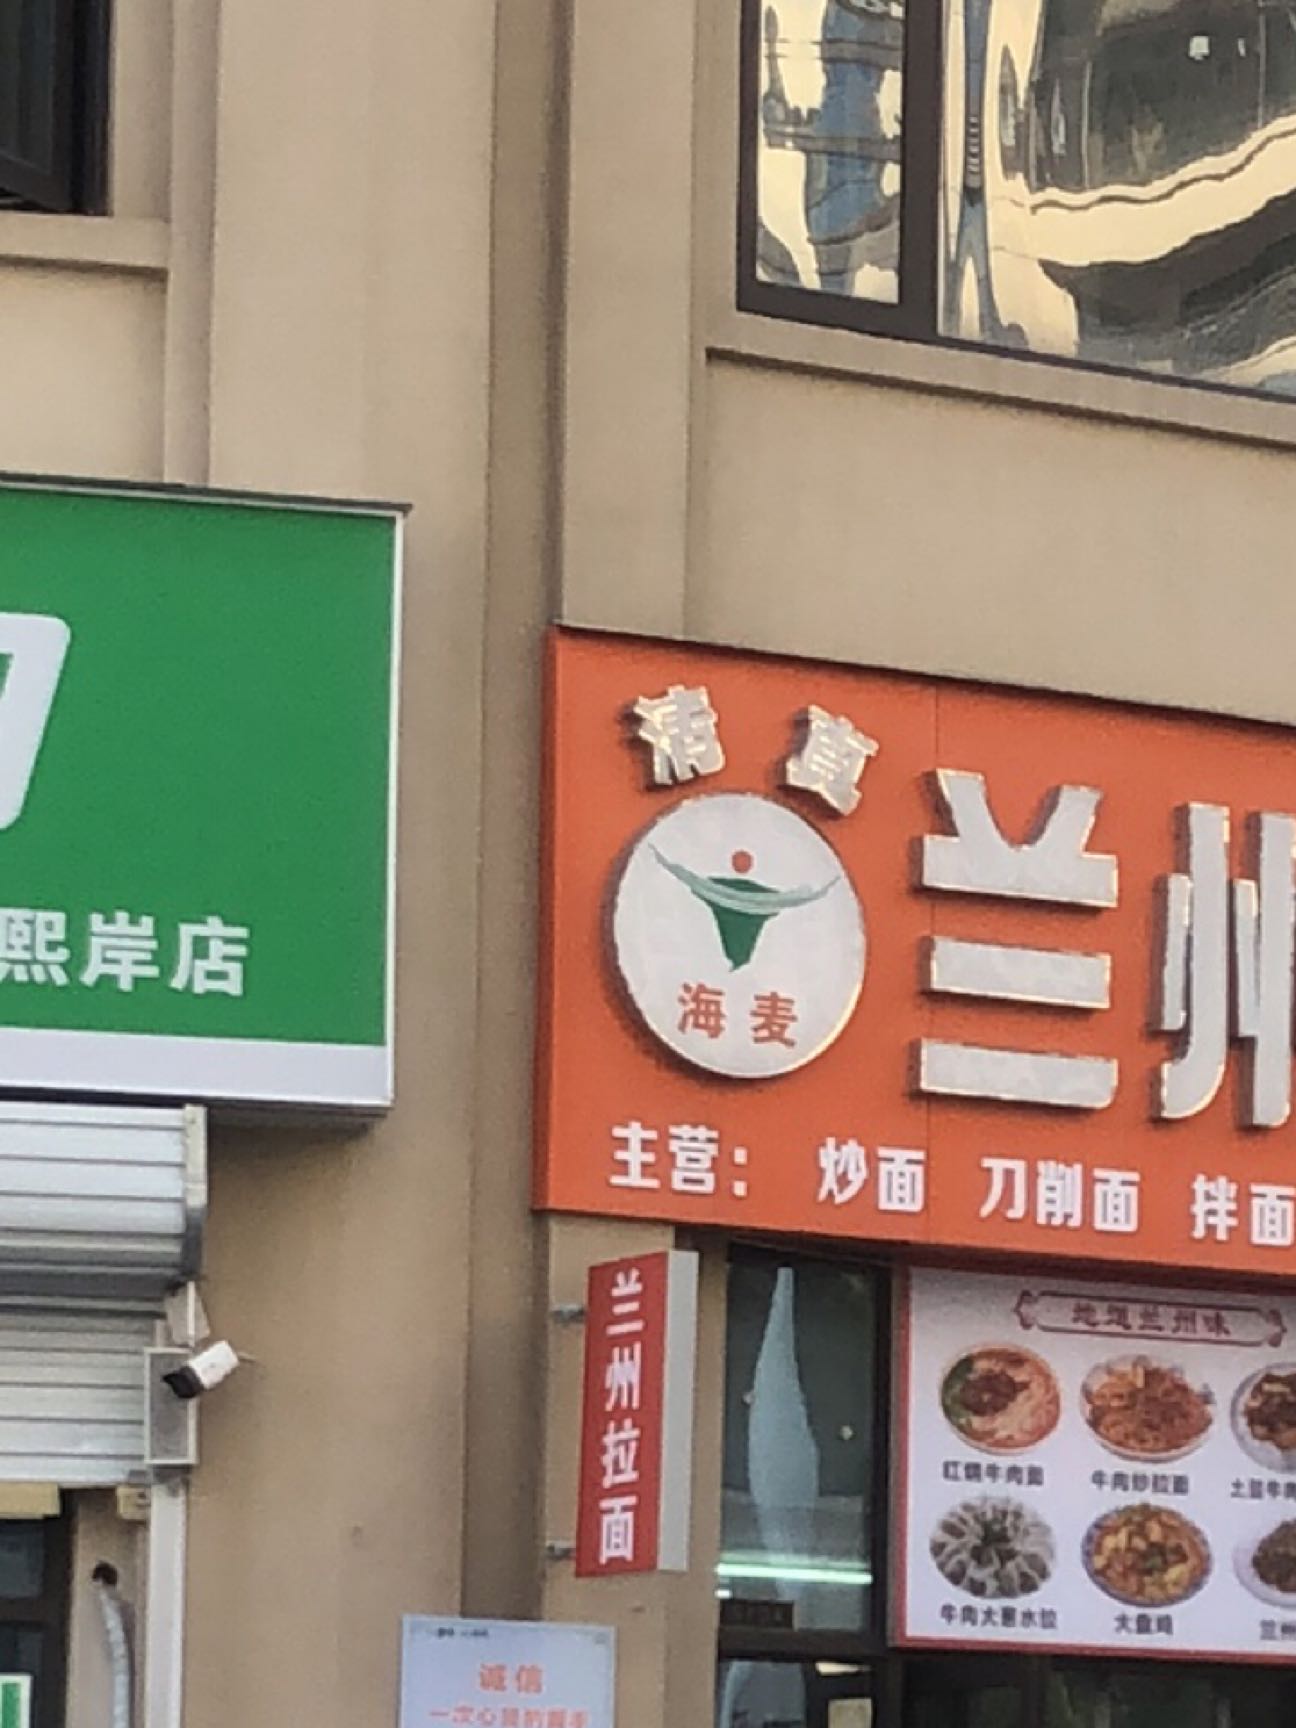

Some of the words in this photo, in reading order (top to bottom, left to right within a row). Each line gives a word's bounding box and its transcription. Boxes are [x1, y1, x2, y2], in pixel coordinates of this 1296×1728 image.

[0, 907, 249, 996] 熙岸店
[677, 983, 798, 1048] 海麦
[817, 1137, 926, 1213] 炒面
[979, 1156, 1140, 1232] 刀削面
[1190, 1173, 1296, 1246] 拌面
[598, 1267, 645, 1565] 兰州拉面
